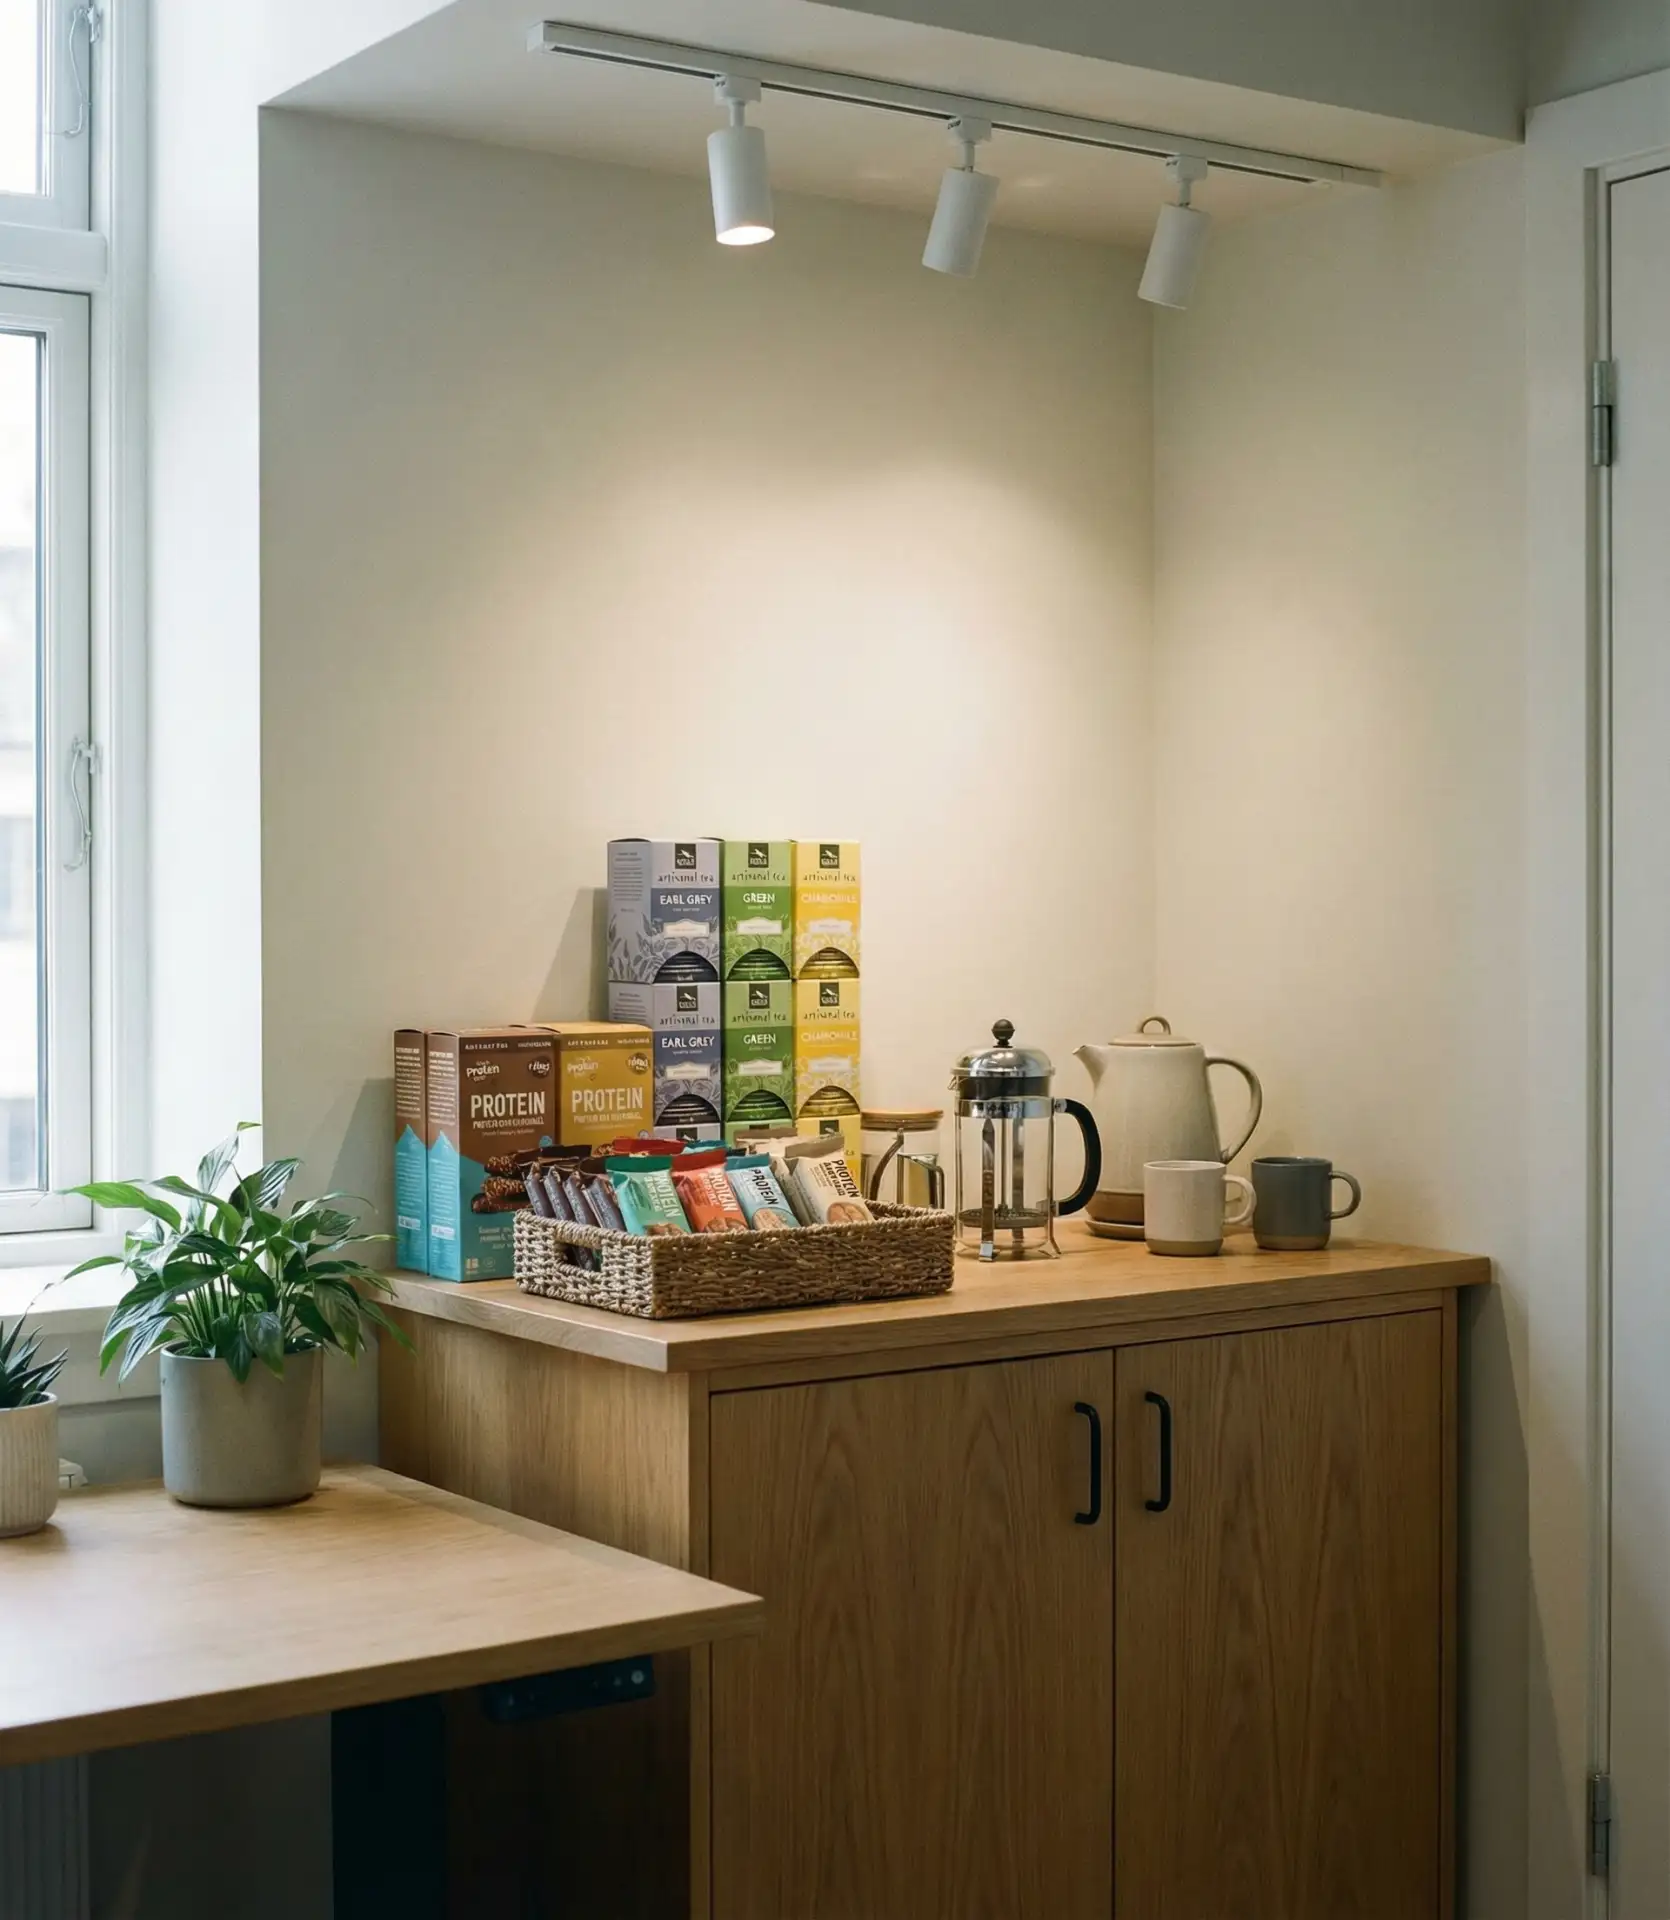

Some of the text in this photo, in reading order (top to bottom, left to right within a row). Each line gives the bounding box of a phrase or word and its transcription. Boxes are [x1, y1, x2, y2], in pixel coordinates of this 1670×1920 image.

[686, 894, 713, 905] GREY
[742, 892, 776, 904] GREEN
[661, 1036, 687, 1049] EARL
[688, 1035, 715, 1047] GREY
[471, 1091, 546, 1119] PROTEIN
[571, 1087, 643, 1113] PROTEIN
[751, 1169, 780, 1205] PROTEIN
